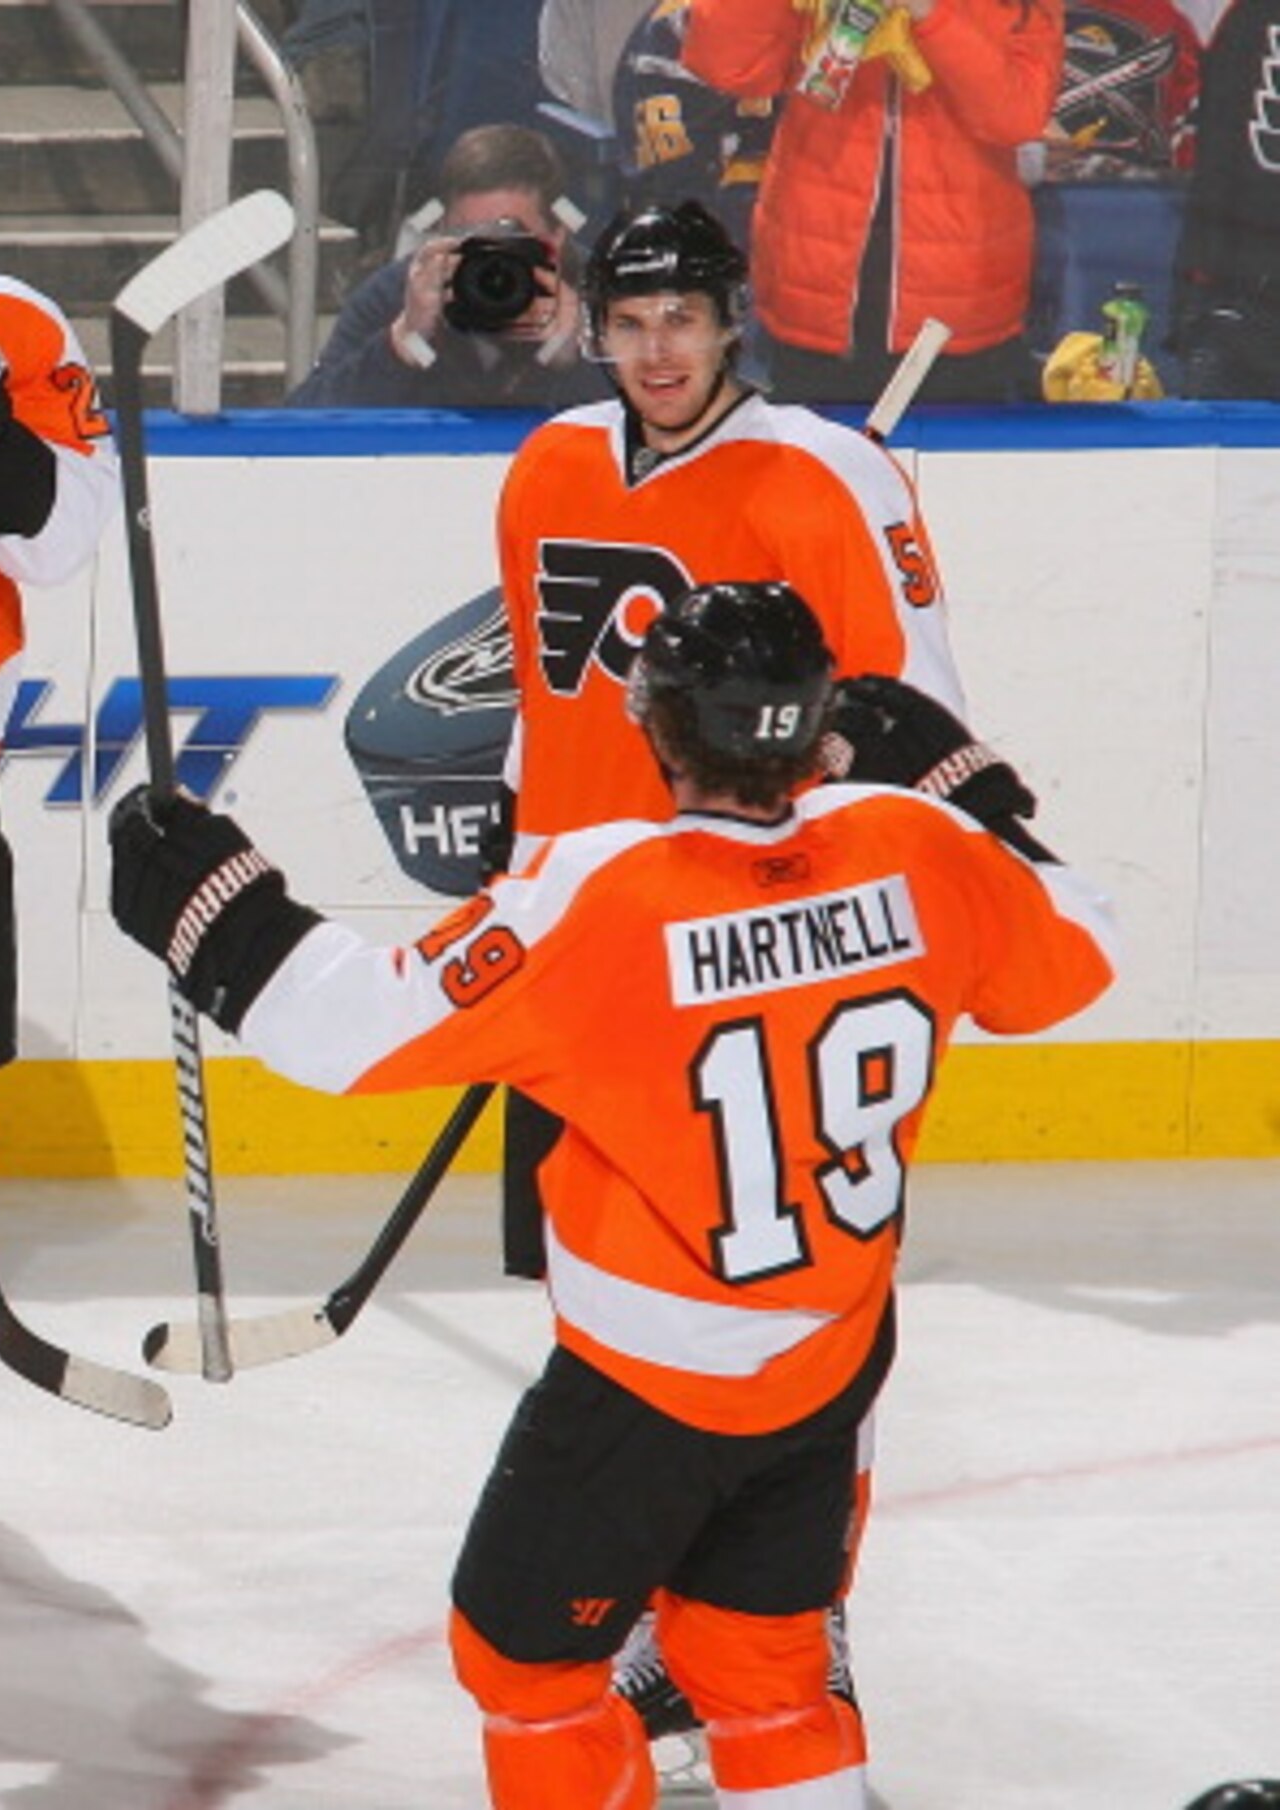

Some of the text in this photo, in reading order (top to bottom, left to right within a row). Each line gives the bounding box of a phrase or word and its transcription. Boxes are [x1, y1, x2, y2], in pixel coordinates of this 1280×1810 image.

[755, 703, 802, 740] 19
[400, 804, 503, 857] HE
[688, 888, 912, 993] HARTNELL
[687, 985, 937, 1288] 19
